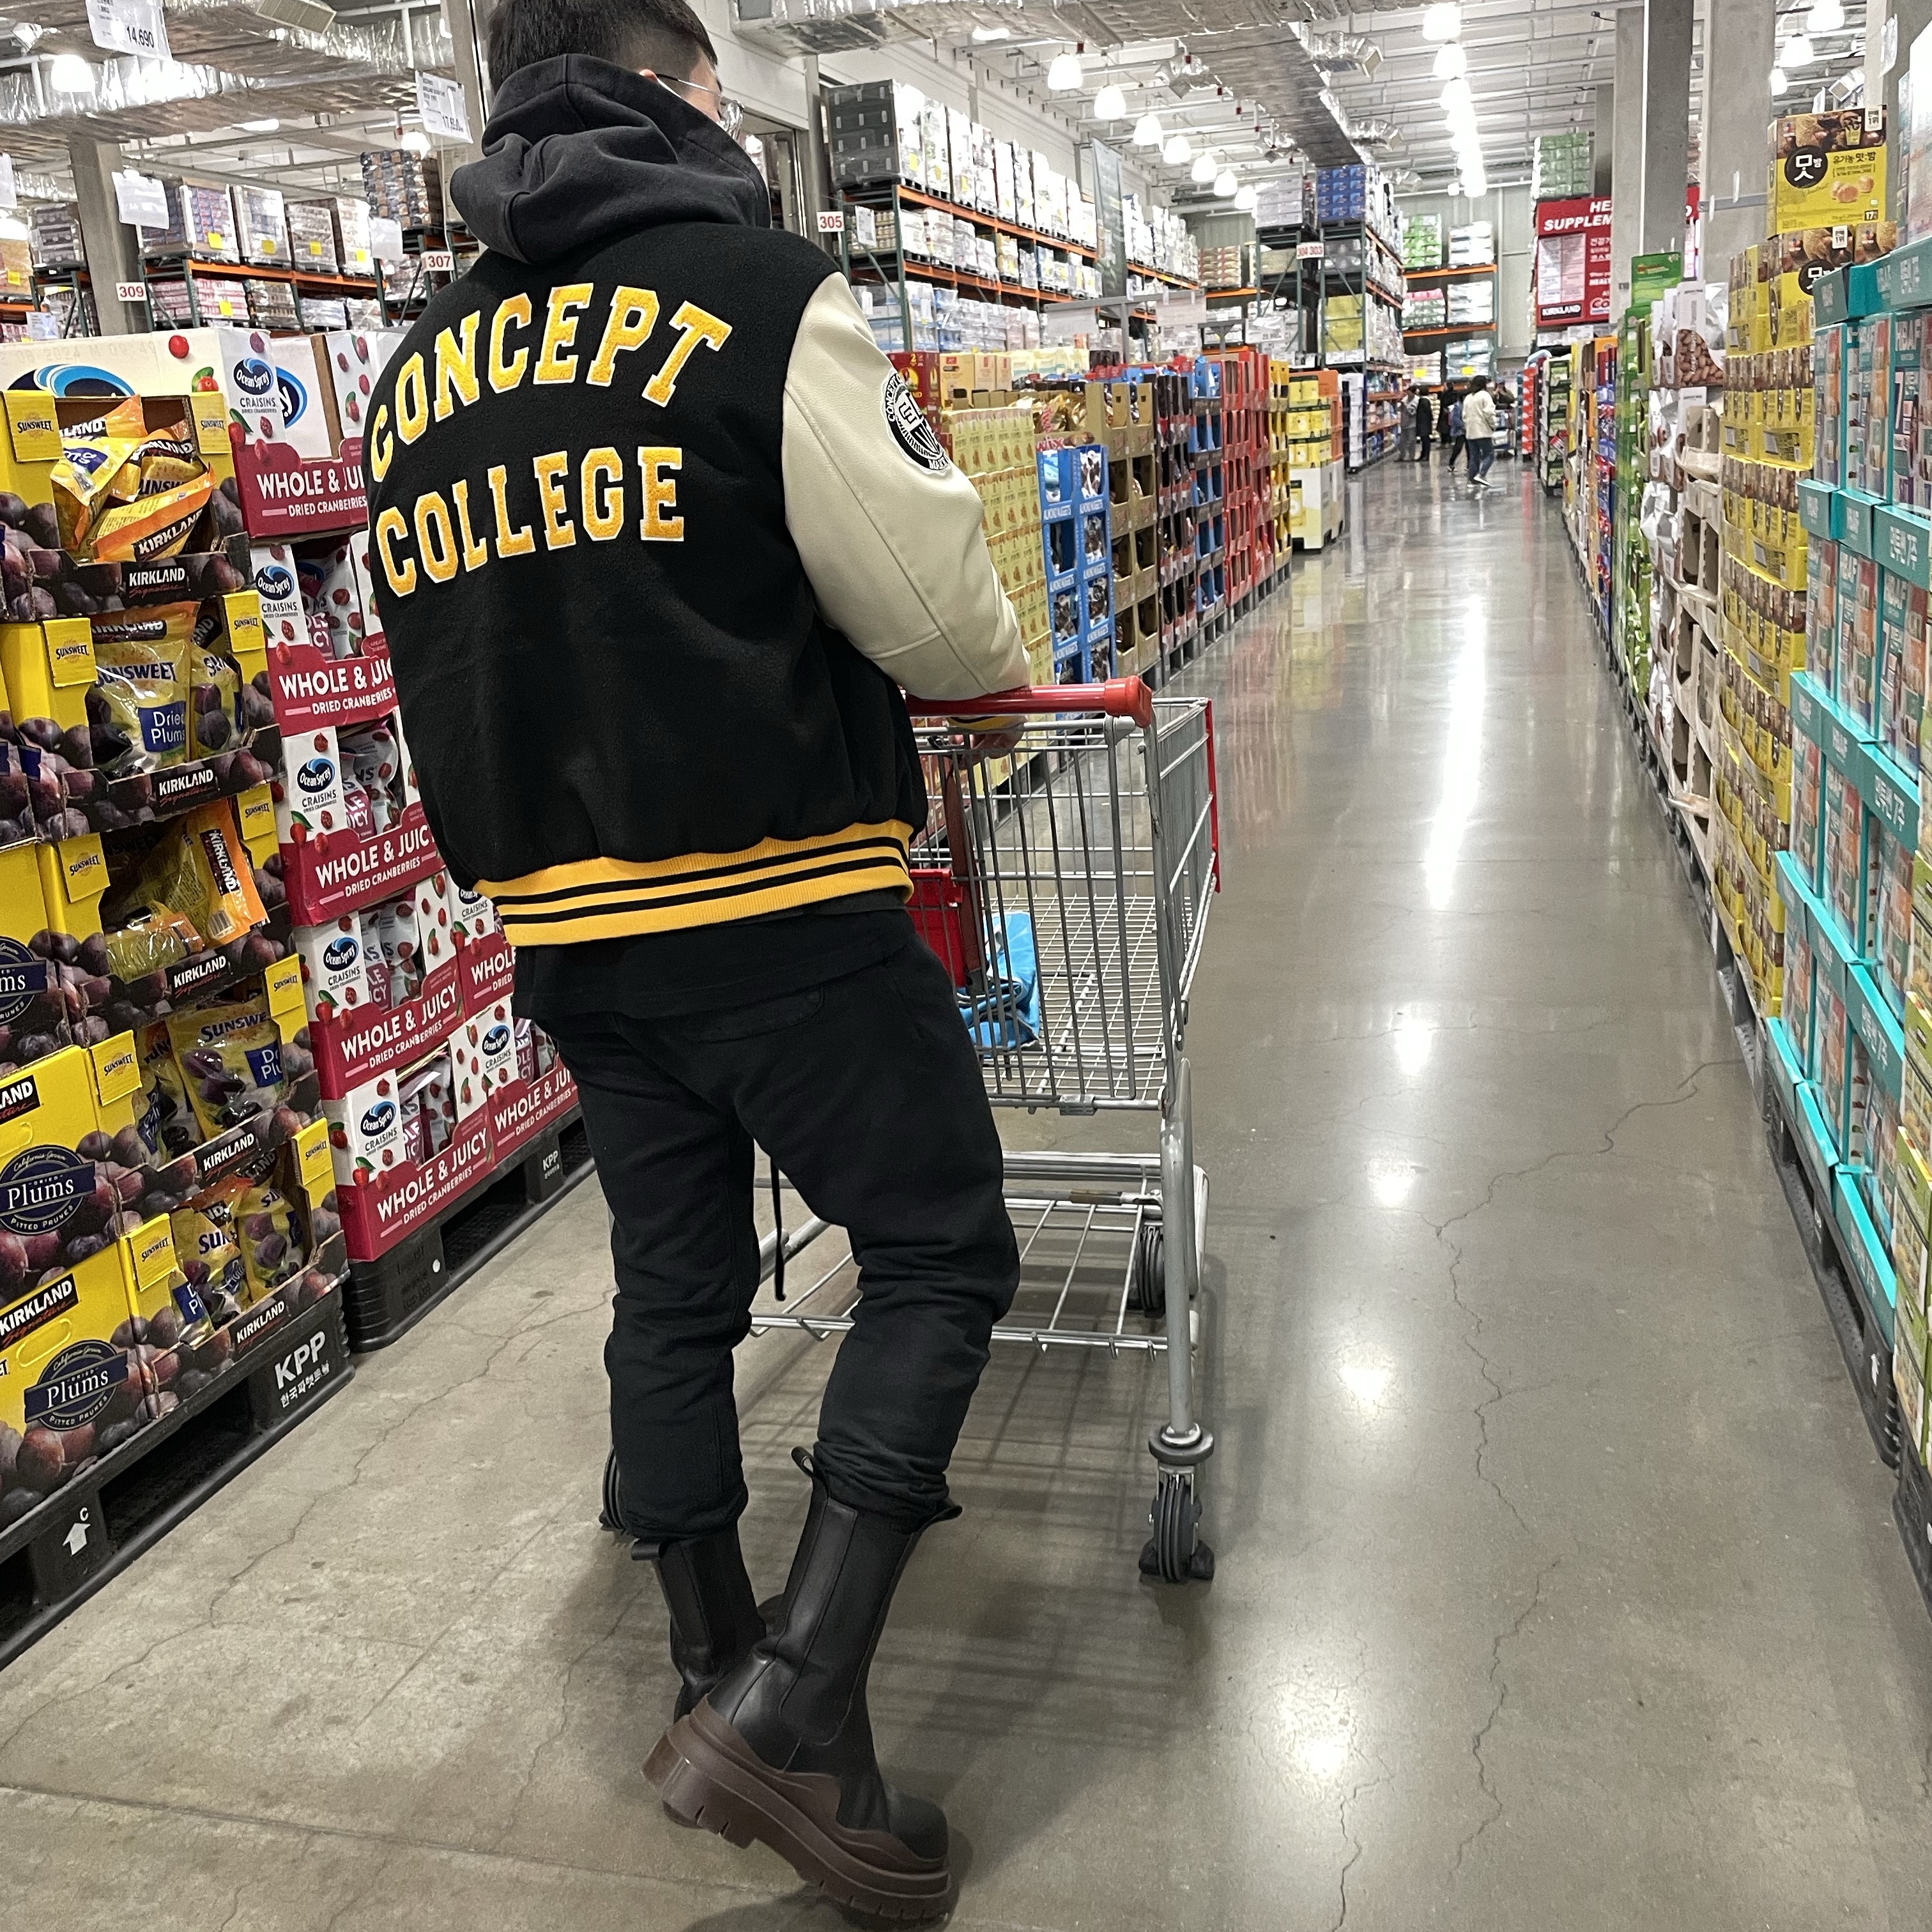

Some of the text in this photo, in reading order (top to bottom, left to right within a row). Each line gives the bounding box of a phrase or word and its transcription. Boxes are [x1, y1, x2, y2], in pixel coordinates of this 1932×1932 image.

[1590, 200, 1613, 213] HE
[820, 215, 843, 230] 305
[1544, 214, 1612, 231] SUPPLEM
[427, 255, 452, 270] 307
[119, 285, 144, 300] 309
[371, 282, 733, 482] CONCEPT
[240, 397, 276, 408] CRAISINS
[17, 419, 54, 434] SUNSWEET
[256, 470, 324, 500] WHOLE
[327, 468, 341, 493] &
[288, 503, 316, 518] DRIED
[376, 447, 685, 597] COLLEGE
[129, 568, 185, 587] KIRKLAND
[257, 576, 291, 595] Ocean Spray
[261, 601, 298, 613] CRAISINS
[234, 617, 260, 631] SUNSWEET
[56, 645, 90, 660] SUNSWEET
[95, 661, 178, 688] SUNSWEET
[279, 668, 349, 700] WHOLE
[353, 666, 367, 690] &
[312, 700, 341, 716] DRIED
[158, 769, 213, 796] KIRKLAND
[300, 766, 332, 788] Ocean Spray
[302, 789, 337, 808] CRAISINS
[244, 802, 271, 818] SUNSWEET
[69, 854, 101, 876] SUNSWEET
[209, 831, 241, 893] KIRKLAND
[315, 825, 435, 889] WHOLE & JUIC
[345, 856, 421, 897] DRIED CRANBERRIES
[461, 900, 488, 918] CRAISINS
[325, 954, 342, 965] Ocean
[341, 945, 355, 964] Spray
[173, 956, 226, 988] KIRKLAND
[328, 965, 361, 986] CRAISINS
[493, 973, 512, 991] DRIED
[273, 975, 298, 993] SUNSWEET
[0, 1000, 24, 1020] RUNES
[201, 1011, 266, 1042] SUNSWE
[341, 981, 456, 1062] WHOLE & JUICY
[369, 1020, 442, 1068] DRIED CRANBERRIES
[103, 1054, 134, 1077] SUNSWEET
[485, 1048, 512, 1069] CRAISINS
[494, 1068, 571, 1133] WHOLE & JUI
[516, 1087, 571, 1136] DRIED CRANBERRIES
[363, 1107, 392, 1131] Ocean Spray
[305, 1140, 328, 1160] SUNSWEET
[365, 1127, 397, 1151] CRAISINS
[14, 1153, 46, 1172] California
[203, 1133, 255, 1172] KIRKLAND
[543, 1150, 558, 1170] KPP
[377, 1128, 487, 1223] WHOLE & JUICY
[8, 1179, 74, 1210] Plums
[403, 1165, 472, 1224] DRIED CRANBERRIES
[10, 1204, 73, 1230] PITTED PRUNES
[141, 1237, 169, 1262] SUNSWEET
[0, 1280, 72, 1336] KIRKLAND
[236, 1300, 285, 1344] KIRKLAND
[53, 1349, 83, 1371] California
[274, 1331, 326, 1390] KPP
[47, 1370, 109, 1409] Plums
[49, 1395, 108, 1425] PITTED PRUNES
[80, 1507, 89, 1521] C
